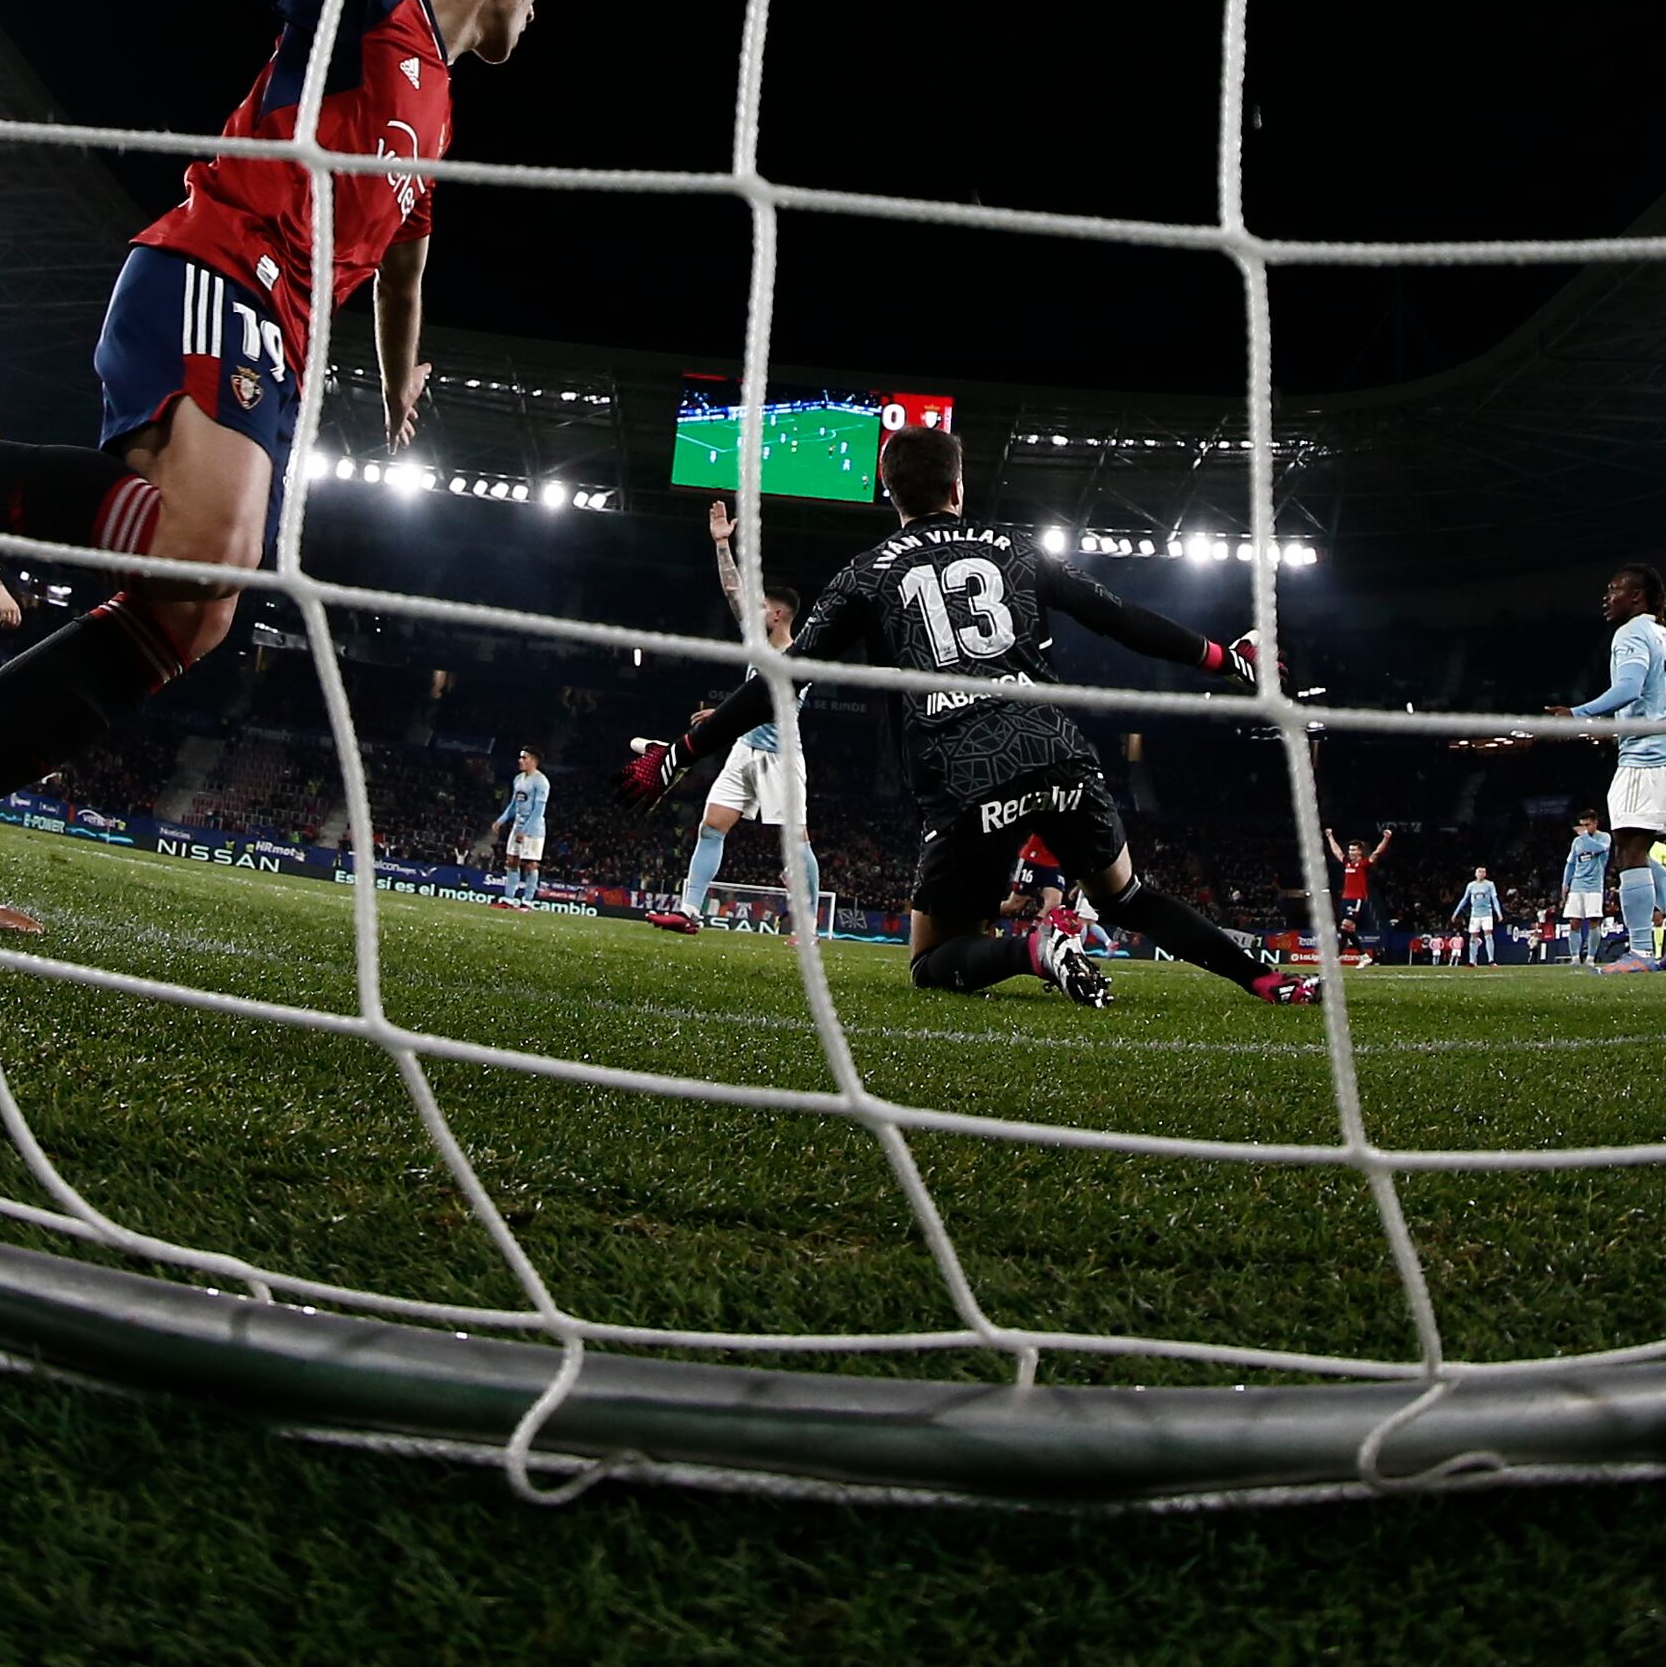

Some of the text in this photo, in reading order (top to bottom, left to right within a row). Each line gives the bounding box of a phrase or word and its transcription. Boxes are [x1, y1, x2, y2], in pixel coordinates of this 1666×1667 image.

[232, 301, 286, 383] 19
[881, 402, 906, 431] 0
[872, 528, 1012, 570] IVÁN VILLAR
[897, 557, 1017, 668] 13
[979, 781, 1085, 834] Recalvi
[157, 838, 281, 873] NISSAN
[255, 840, 304, 861] HRmot
[1020, 868, 1034, 884] 16
[394, 880, 416, 894] es
[418, 883, 436, 896] el
[437, 886, 496, 905] motor
[530, 900, 598, 917] cambio
